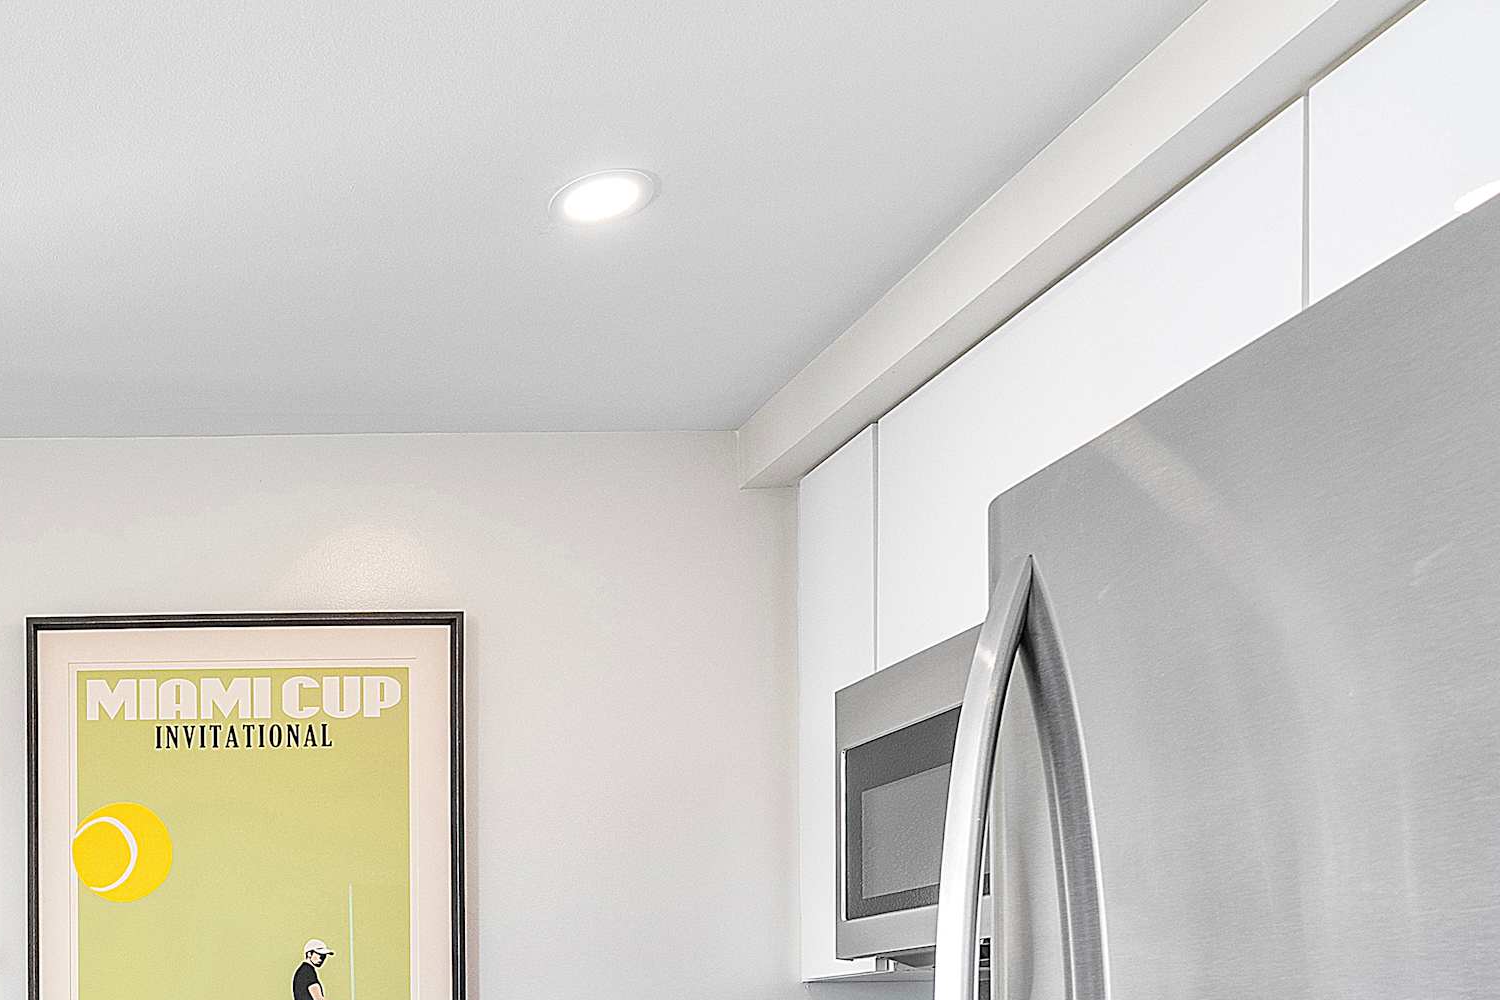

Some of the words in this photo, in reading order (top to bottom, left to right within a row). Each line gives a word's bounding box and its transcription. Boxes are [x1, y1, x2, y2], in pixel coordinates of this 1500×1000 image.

[85, 675, 272, 721] MIAMI
[281, 675, 402, 719] CUP
[154, 723, 333, 749] INVITATIONAL
